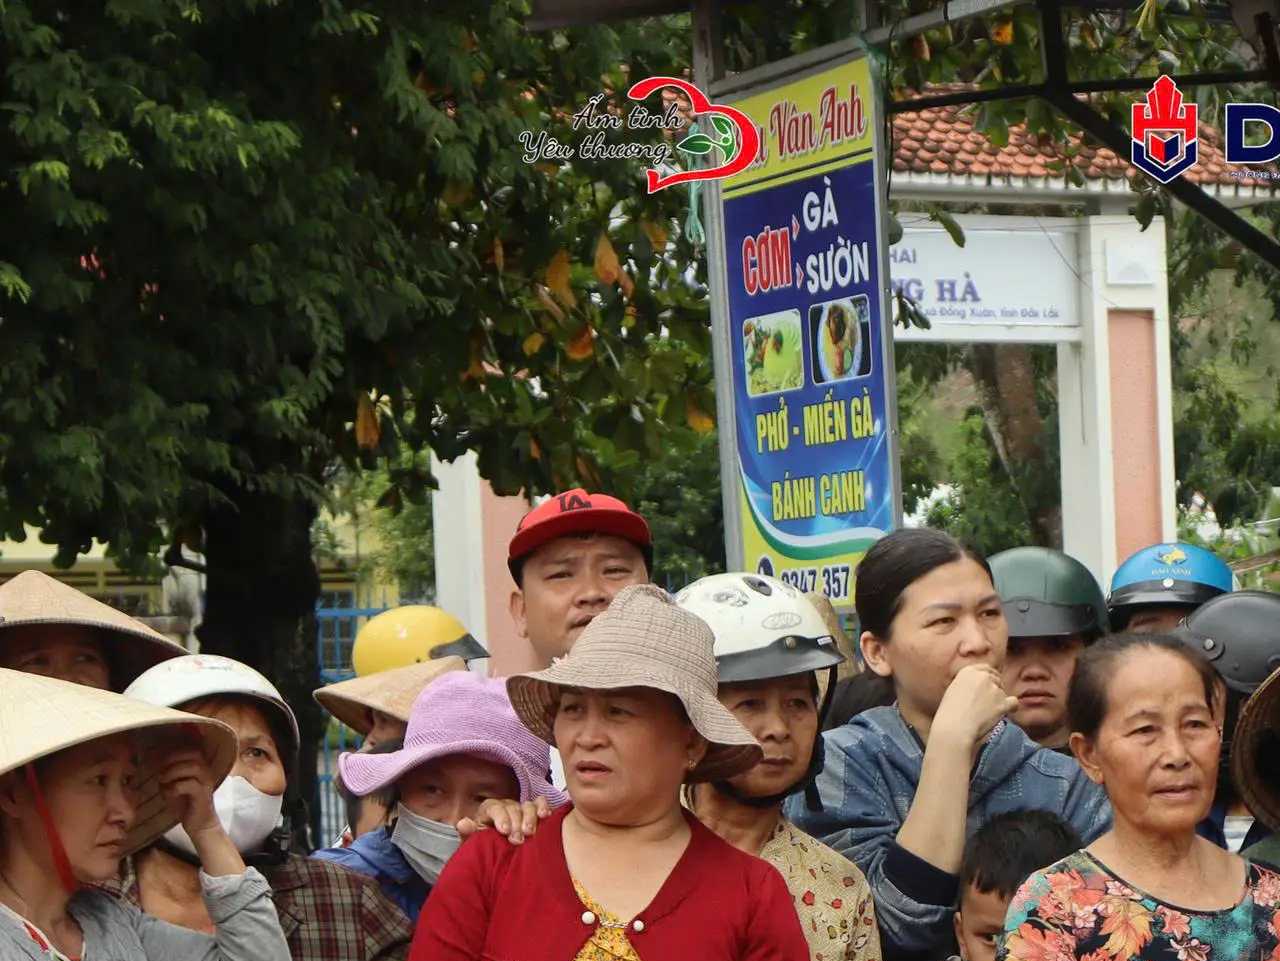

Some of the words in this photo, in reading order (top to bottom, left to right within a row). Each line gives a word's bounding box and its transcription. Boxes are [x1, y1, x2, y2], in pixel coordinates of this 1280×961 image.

[770, 101, 817, 160] Vân
[819, 84, 867, 147] Anh
[802, 178, 839, 231] GÀ
[742, 225, 792, 295] CƠM
[805, 238, 870, 295] SƯỜN
[936, 271, 982, 303] HÀ
[756, 397, 789, 454] PHỞ
[803, 388, 848, 447] MIẾN
[851, 387, 875, 438] GÀ
[772, 471, 816, 522] BÁNH
[820, 470, 865, 516] CANH
[822, 565, 850, 599] 357
